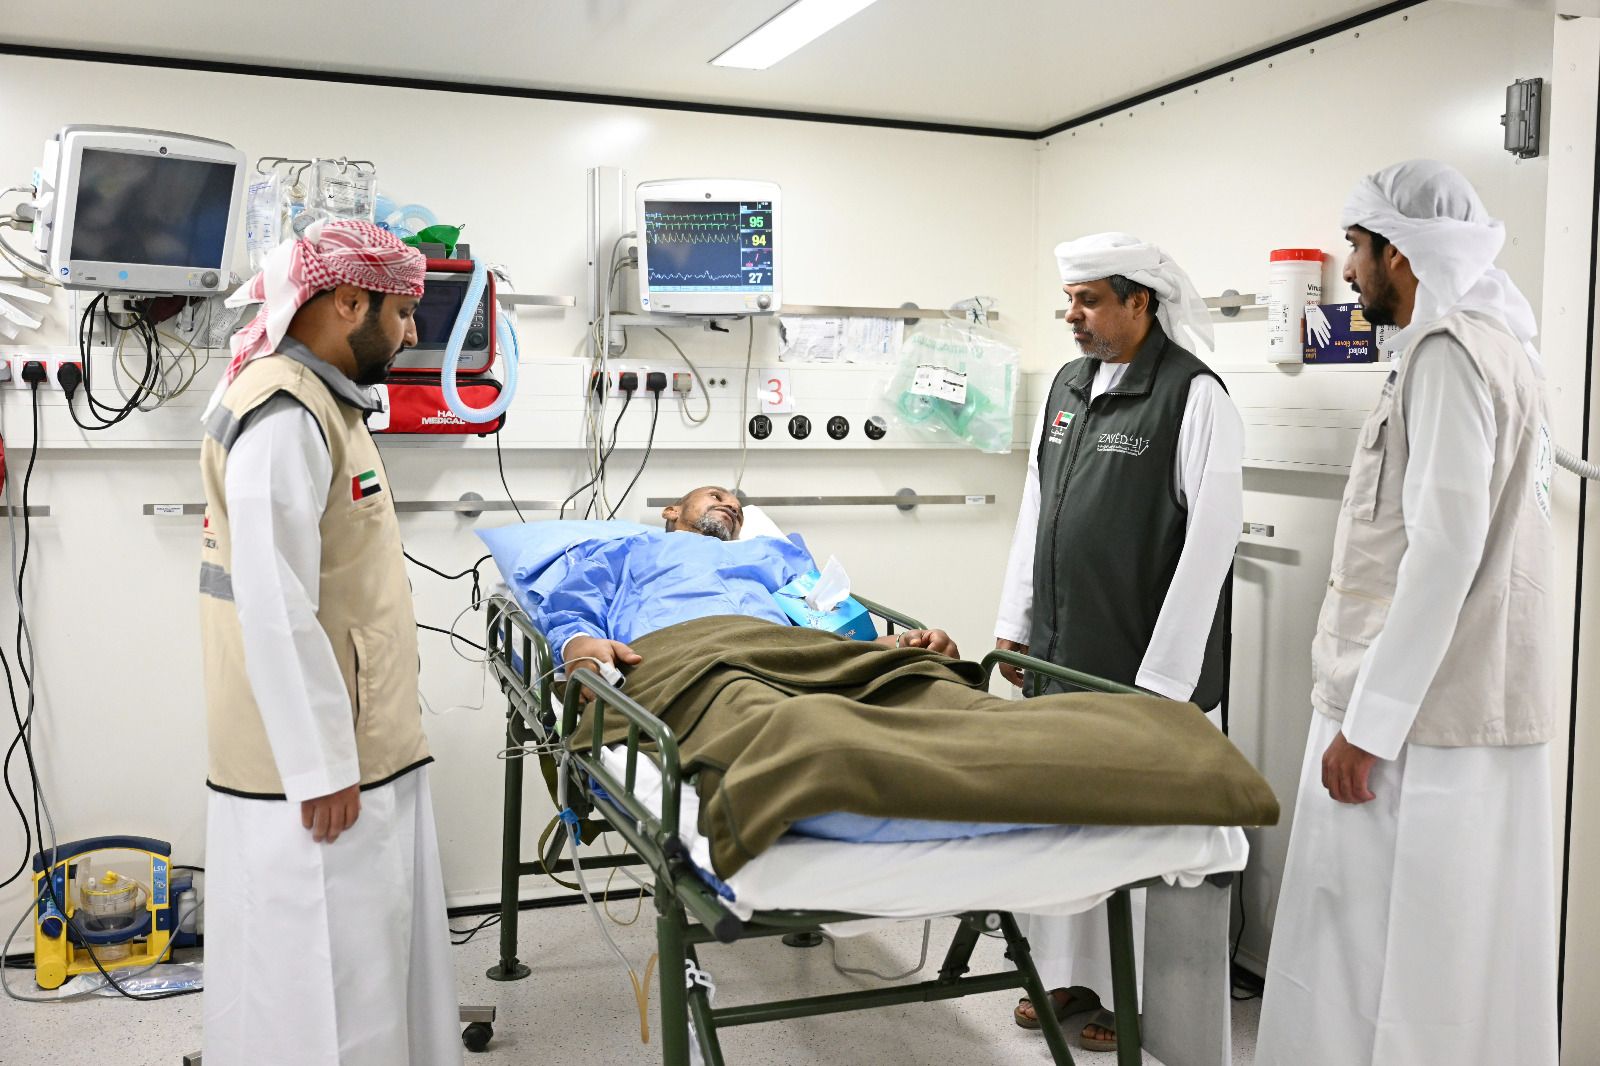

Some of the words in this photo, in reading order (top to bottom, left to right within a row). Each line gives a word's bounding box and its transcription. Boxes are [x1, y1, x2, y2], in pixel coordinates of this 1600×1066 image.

[749, 216, 763, 227] 95
[752, 235, 766, 246] 94
[749, 273, 763, 284] 27
[767, 378, 784, 405] 3
[421, 417, 466, 425] MEDICAL
[1099, 433, 1128, 444] ZAYED
